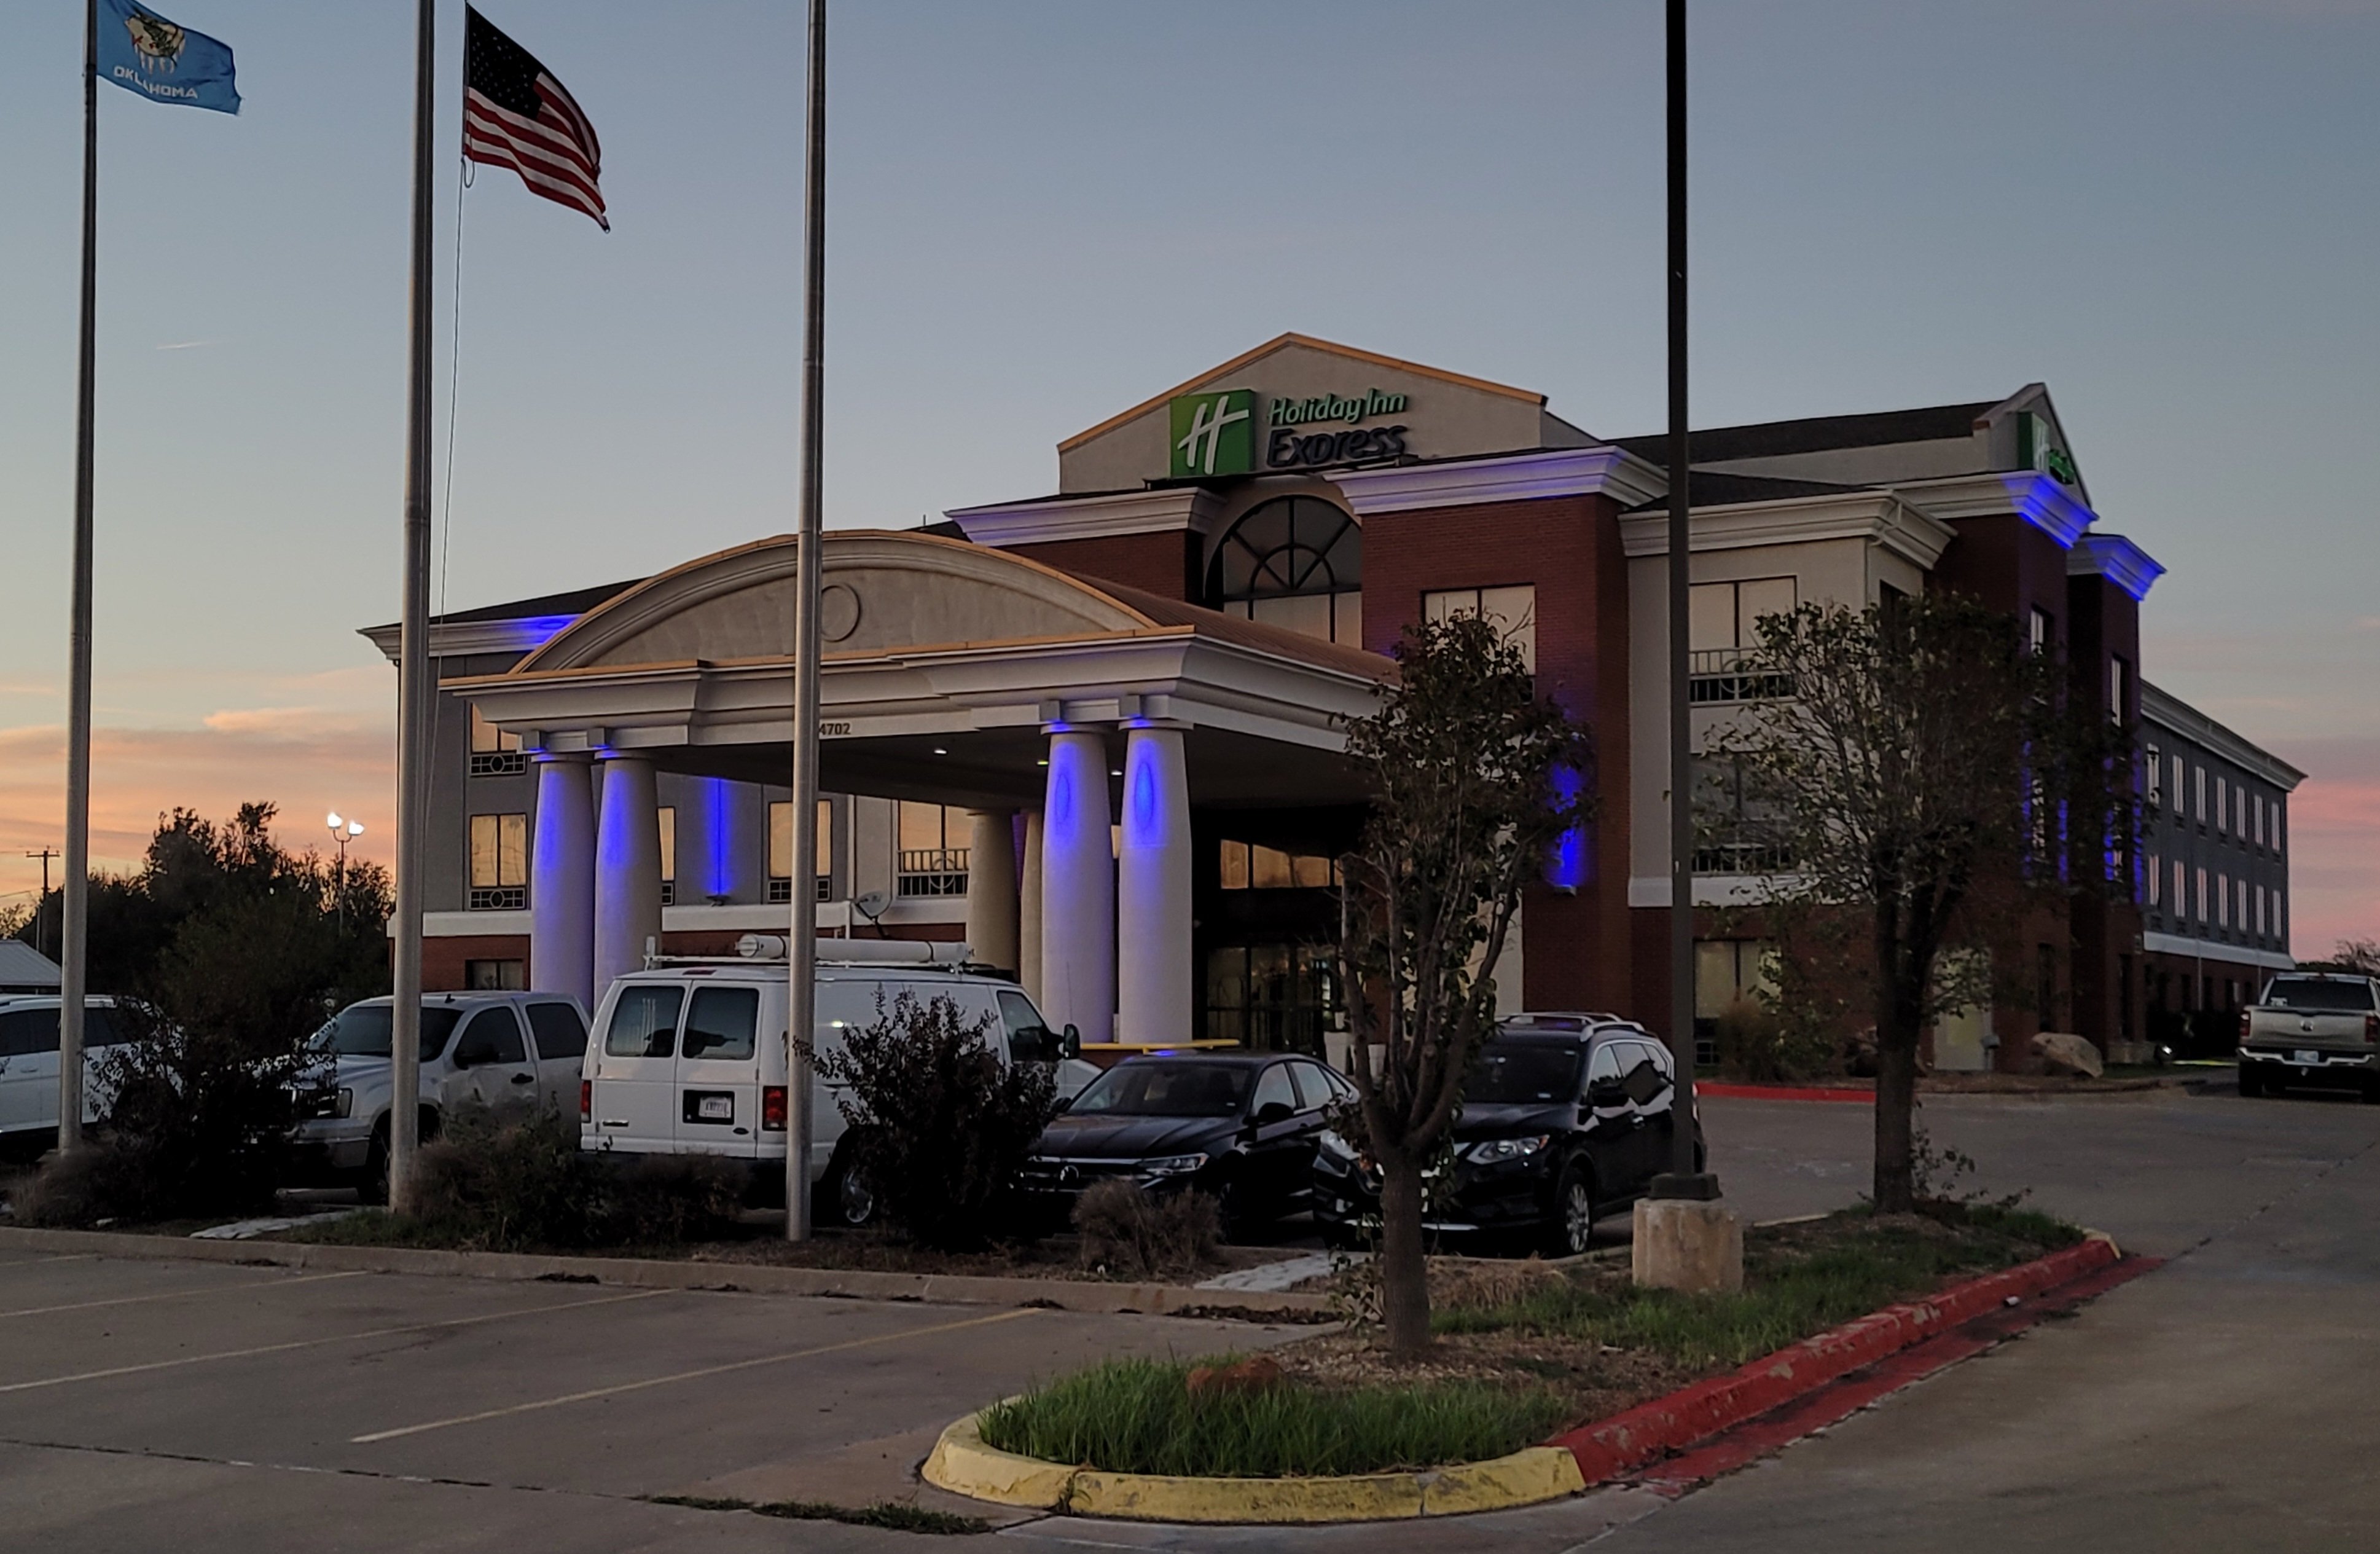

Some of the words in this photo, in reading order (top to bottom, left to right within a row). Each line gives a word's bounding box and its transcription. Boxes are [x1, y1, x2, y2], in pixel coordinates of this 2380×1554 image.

[113, 65, 198, 99] OKLAHOMA
[1268, 394, 1361, 425] Holiday
[1365, 388, 1407, 414] Inn
[1177, 395, 1250, 475] H
[1267, 425, 1407, 467] Express
[819, 723, 851, 735] 4702
